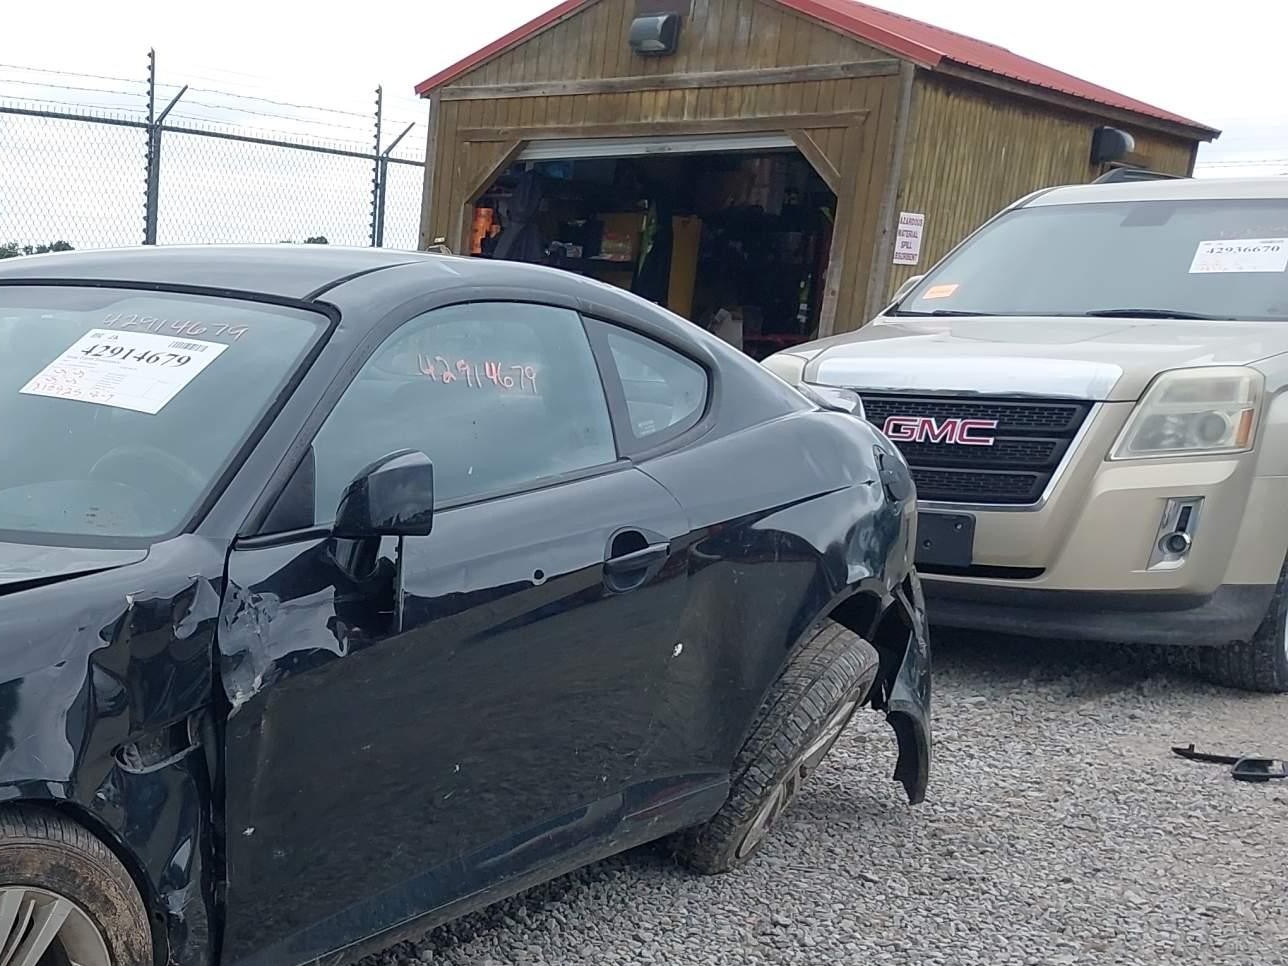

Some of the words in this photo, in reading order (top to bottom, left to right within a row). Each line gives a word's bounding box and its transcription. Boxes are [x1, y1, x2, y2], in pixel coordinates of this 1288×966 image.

[103, 312, 249, 342] 42914679
[81, 343, 192, 368] 42914679
[418, 354, 537, 393] 42914679
[882, 416, 999, 446] GMC
